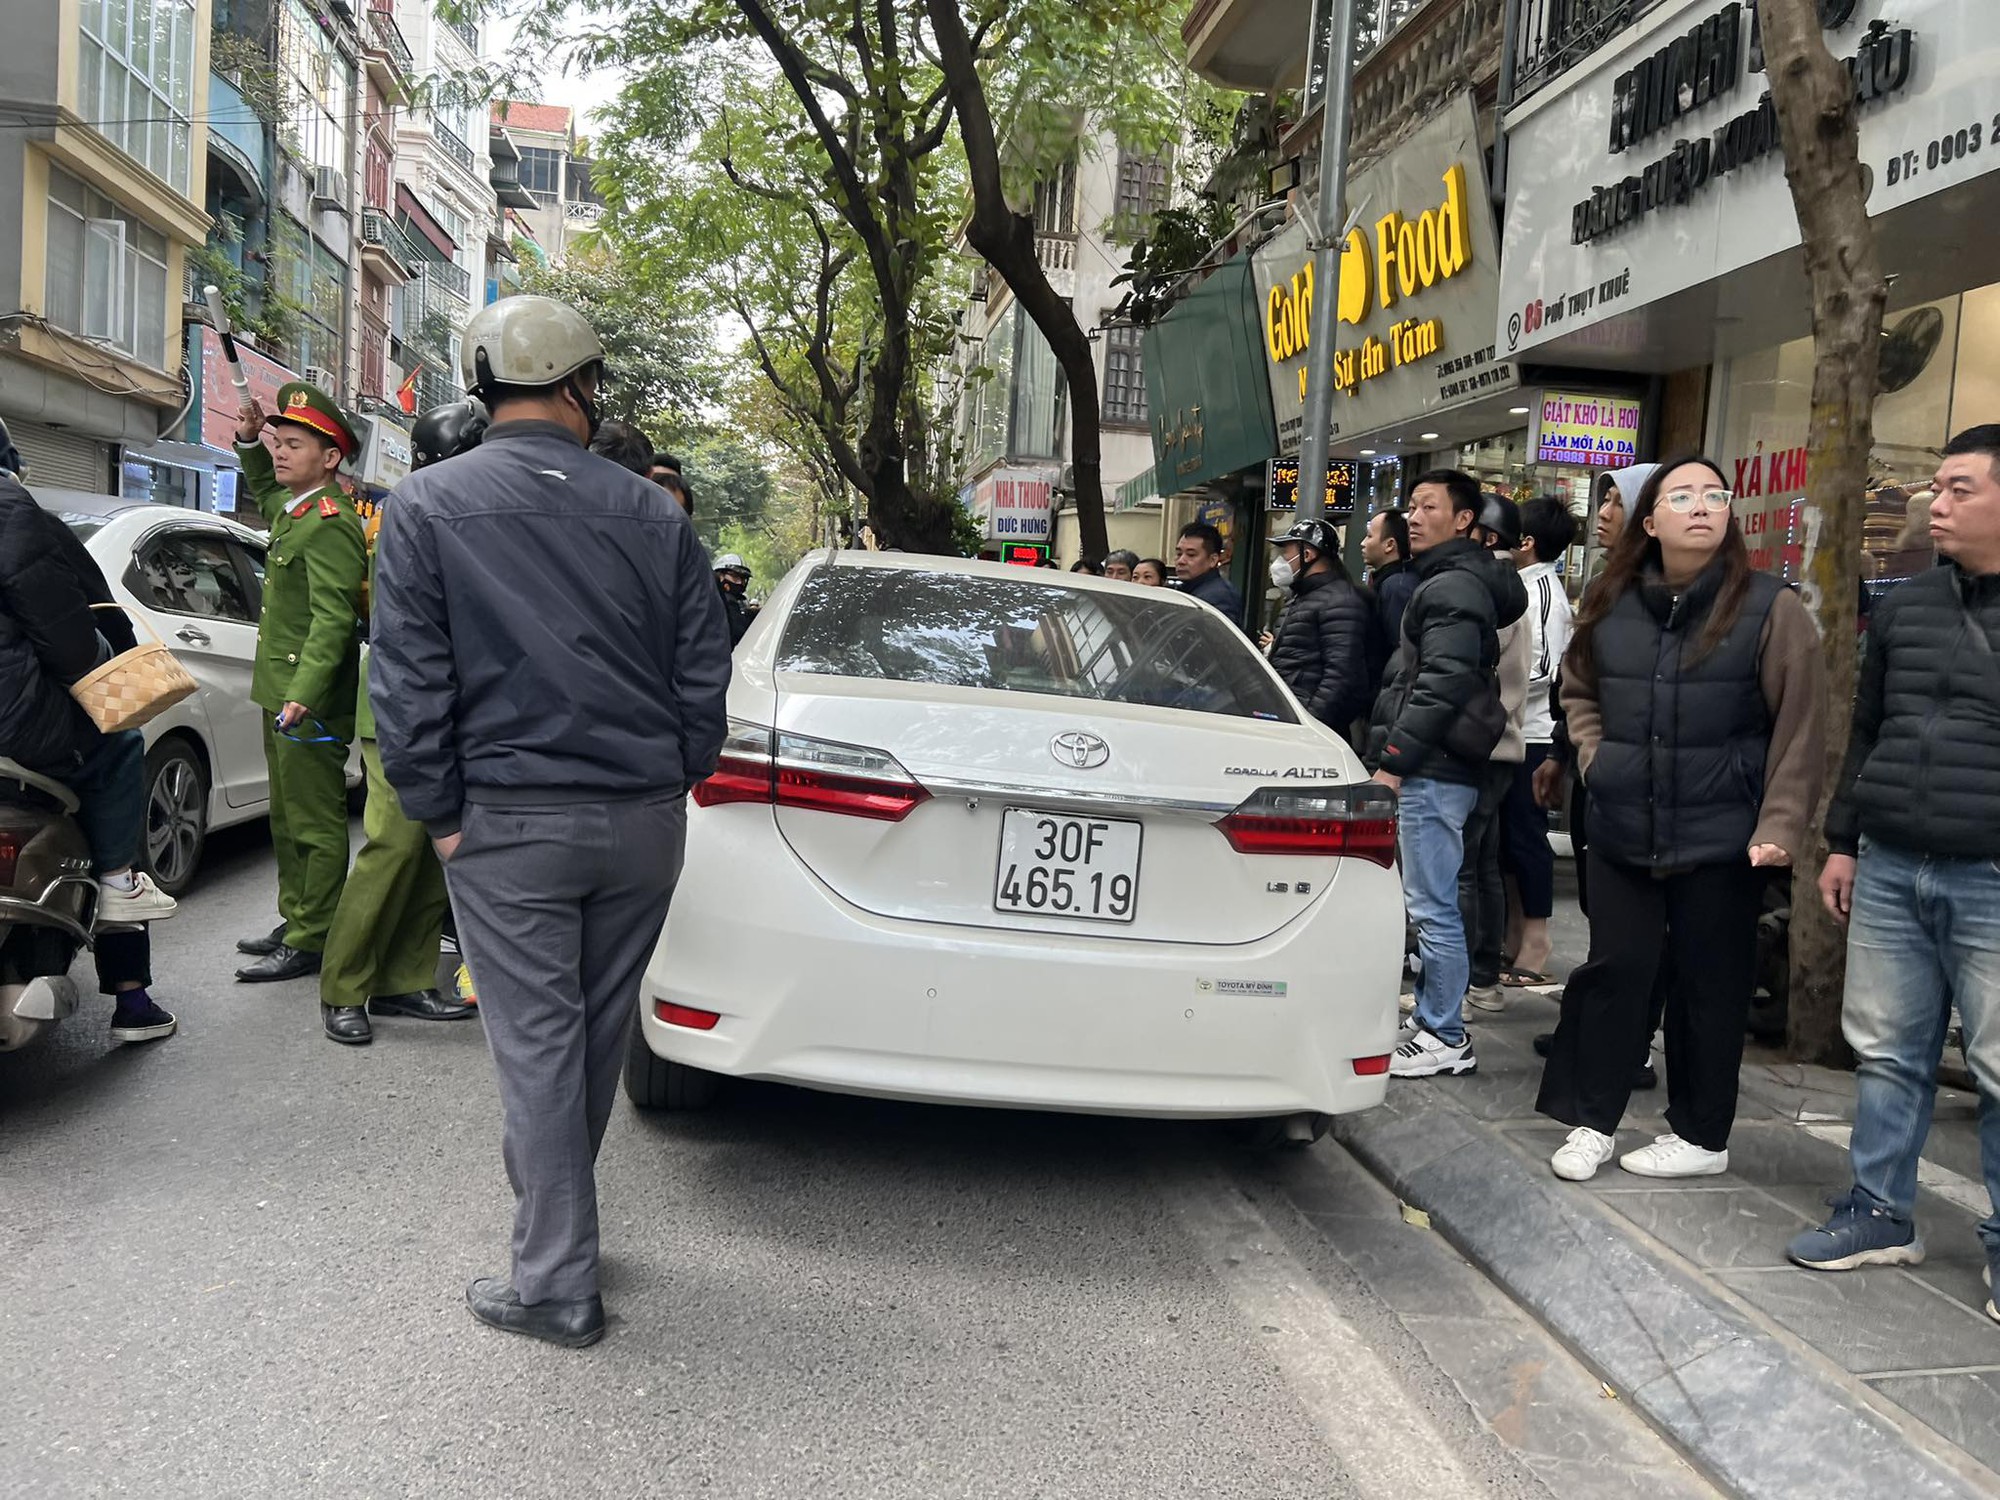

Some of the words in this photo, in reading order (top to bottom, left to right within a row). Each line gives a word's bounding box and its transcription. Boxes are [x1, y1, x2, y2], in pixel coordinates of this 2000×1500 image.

[1887, 150, 1919, 187] ĐT:
[1926, 122, 1982, 171] 0903
[1571, 174, 1642, 245] HÀNG
[1641, 138, 1711, 212] HIỆU
[1267, 261, 1315, 363] Gold
[1375, 162, 1472, 309] Food
[1524, 299, 1543, 334] 86
[1544, 293, 1566, 326] PHỐ
[1360, 336, 1390, 381] An
[1390, 317, 1444, 366] Tâm
[1573, 400, 1598, 426] KHÔ
[1541, 432, 1568, 448] LÀM
[1570, 434, 1594, 450] MỚI
[1596, 436, 1614, 451] ÁO
[1617, 440, 1634, 454] DA
[1589, 452, 1609, 466] 151
[1733, 440, 1763, 499] XẢ
[995, 477, 1015, 509] NHÀ
[1017, 478, 1050, 510] THUỐC
[997, 515, 1018, 533] ĐỨC
[1020, 516, 1048, 534] HƯNG
[1745, 512, 1767, 535] LEN
[1223, 766, 1278, 778] COROLLA
[1281, 766, 1340, 779] ALTIS
[1034, 818, 1109, 865] 30F
[1000, 864, 1132, 916] 465.19
[1217, 981, 1245, 989] TOYOTA
